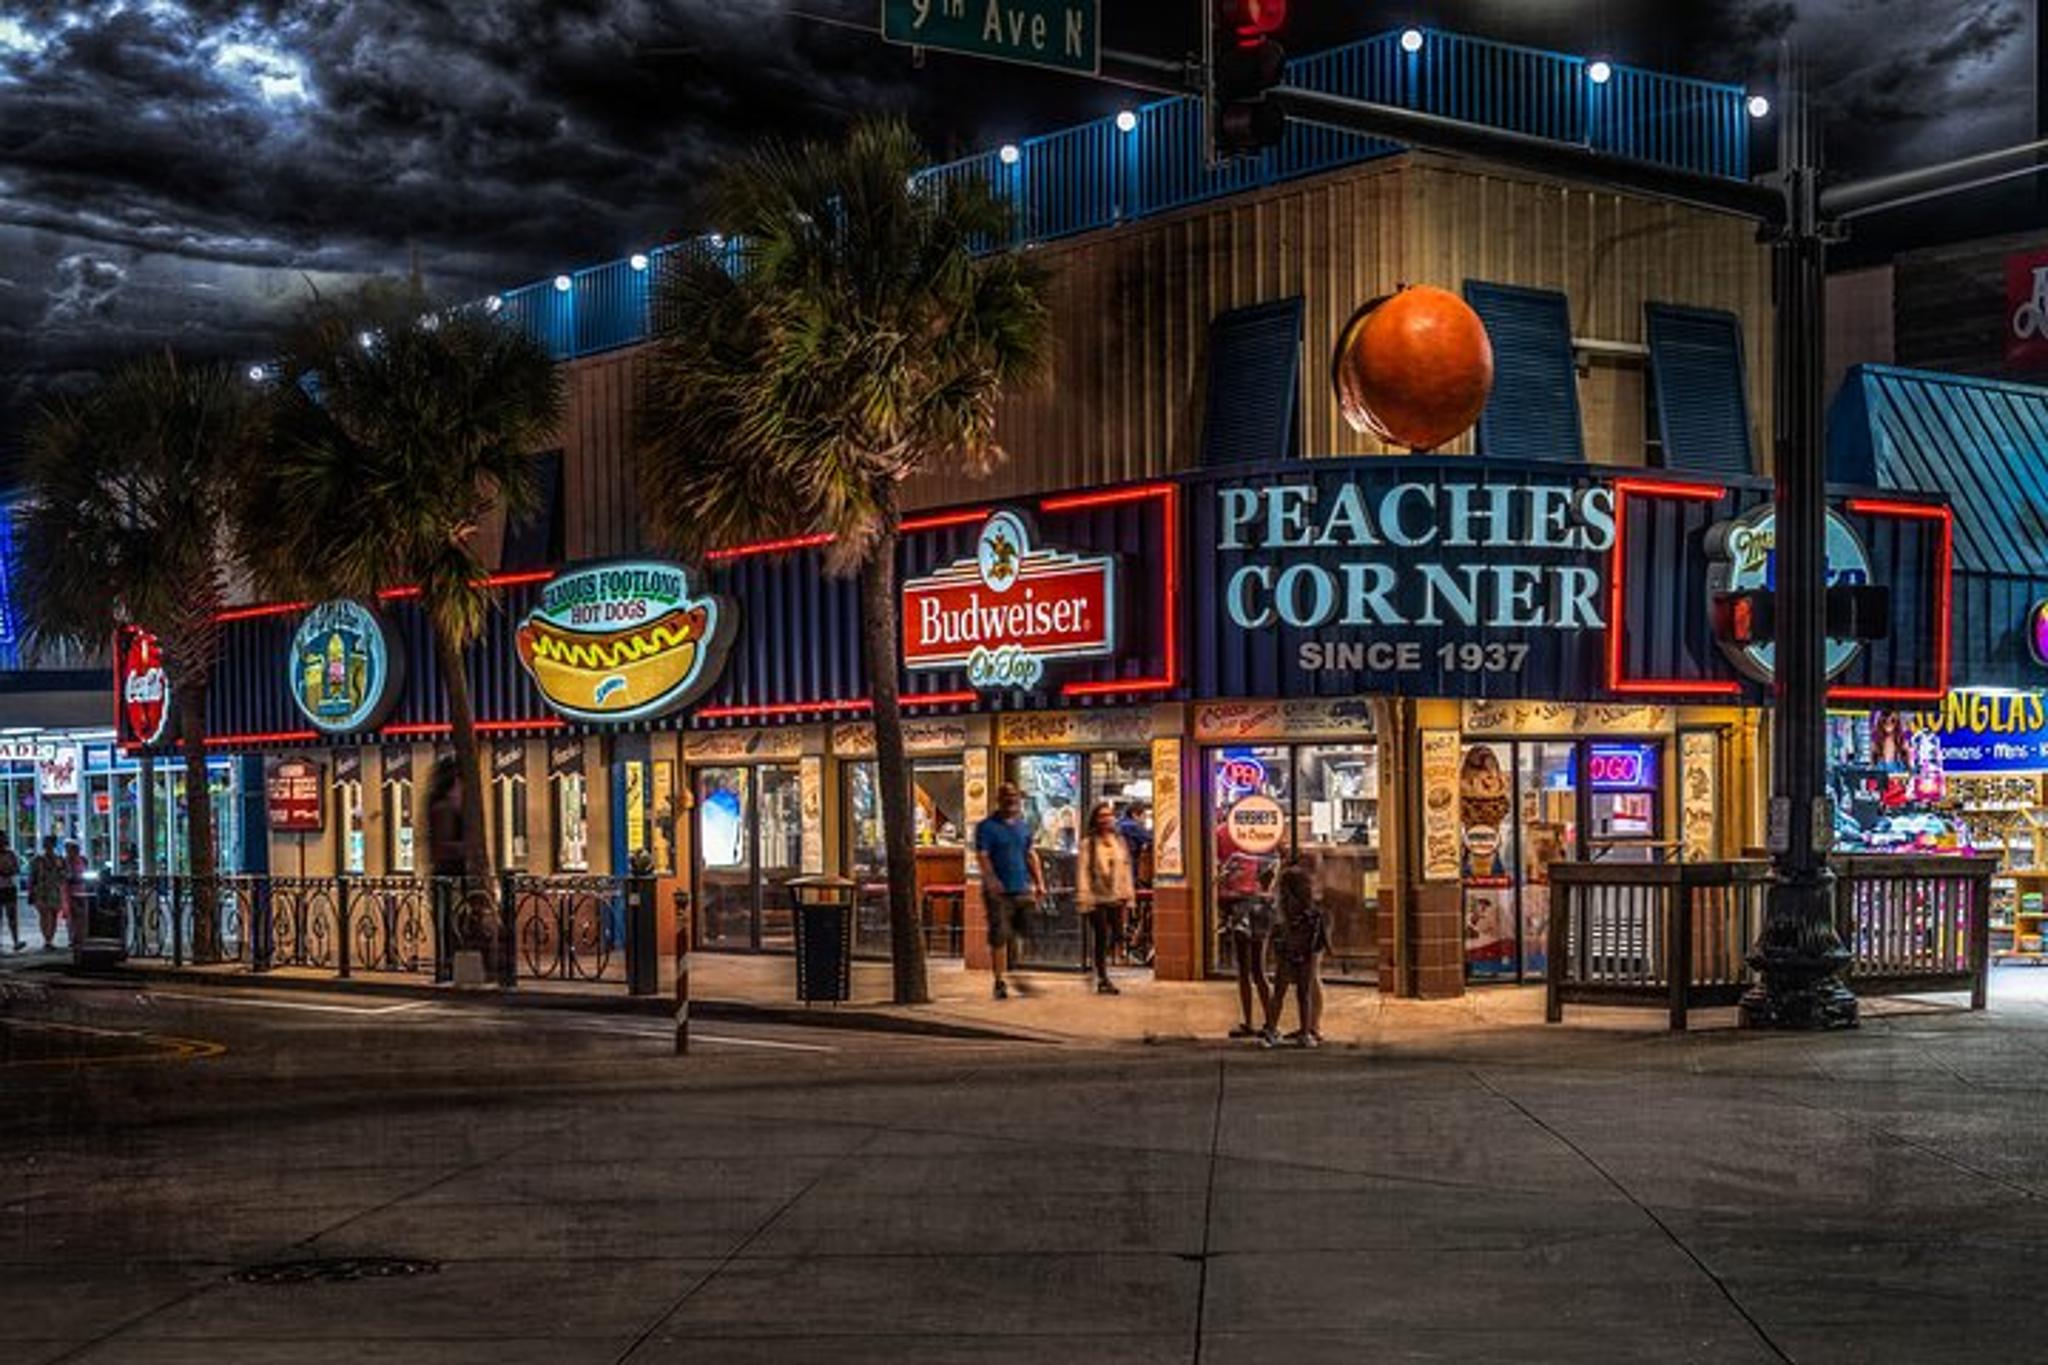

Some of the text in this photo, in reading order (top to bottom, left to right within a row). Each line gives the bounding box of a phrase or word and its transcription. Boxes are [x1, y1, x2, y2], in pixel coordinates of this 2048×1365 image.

[982, 0, 1046, 50] Ave
[1065, 8, 1082, 58] N
[1216, 482, 1616, 551] PEACHES
[571, 600, 647, 624] HOT DOGS
[599, 569, 682, 598] FOOTLONG
[1226, 561, 1608, 629] CORNER
[919, 587, 1088, 646] Budweiser
[1300, 642, 1530, 672] SINCE 1937
